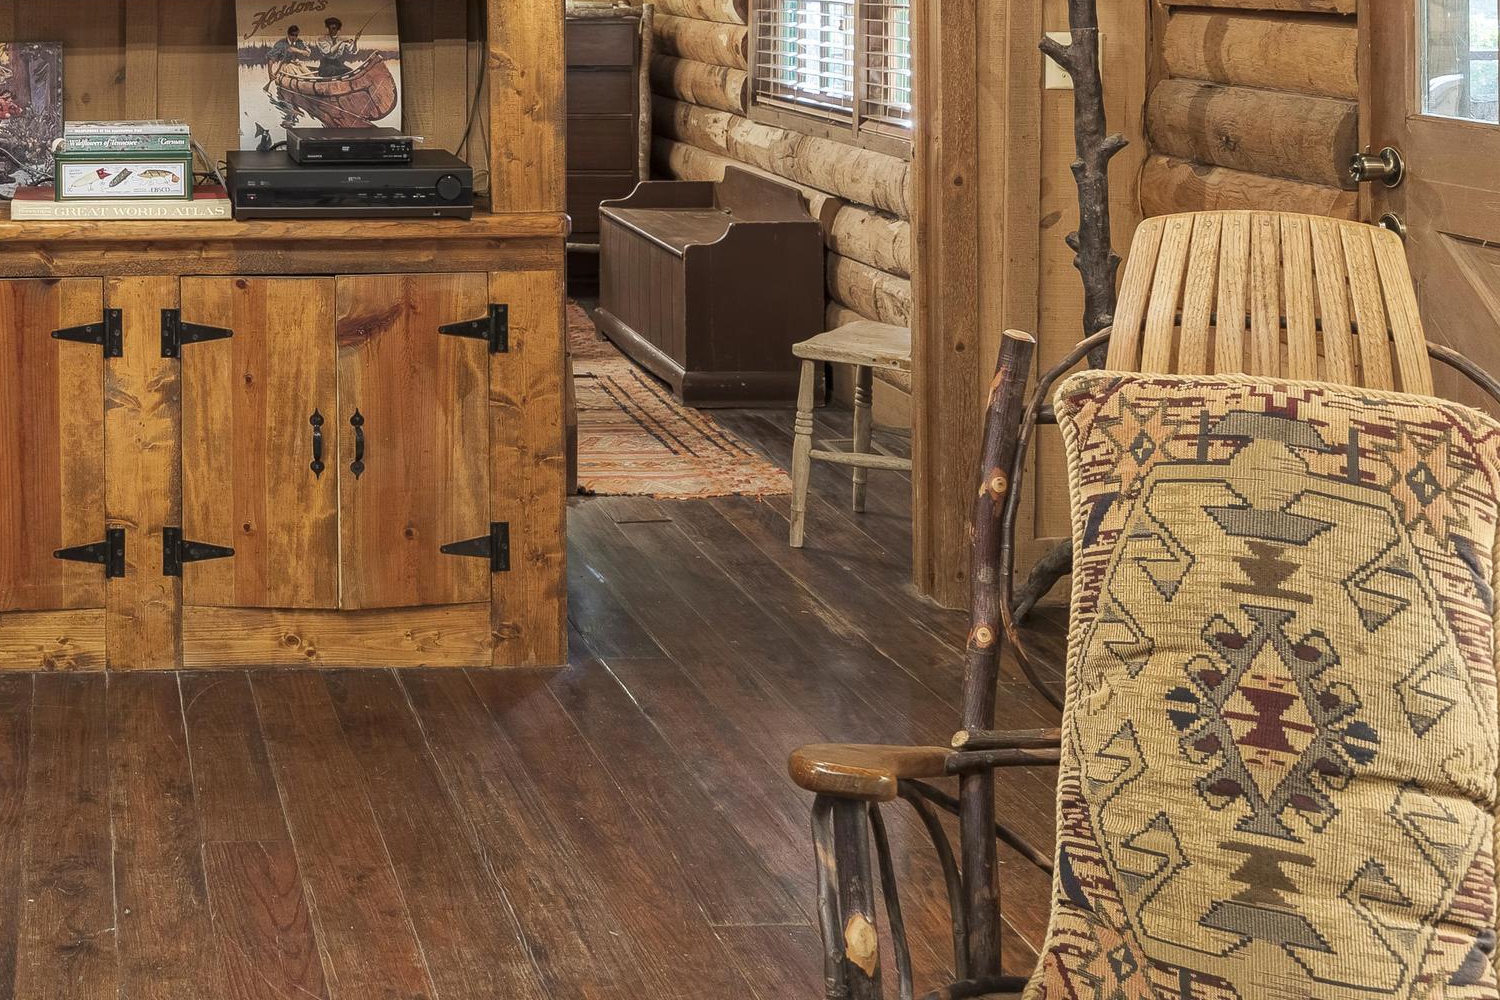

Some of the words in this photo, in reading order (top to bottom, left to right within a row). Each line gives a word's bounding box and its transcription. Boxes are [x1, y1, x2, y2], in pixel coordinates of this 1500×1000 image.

[104, 139, 111, 147] of
[54, 207, 108, 216] GREAT
[114, 207, 167, 216] WORLD
[171, 205, 226, 217] ATLAS
